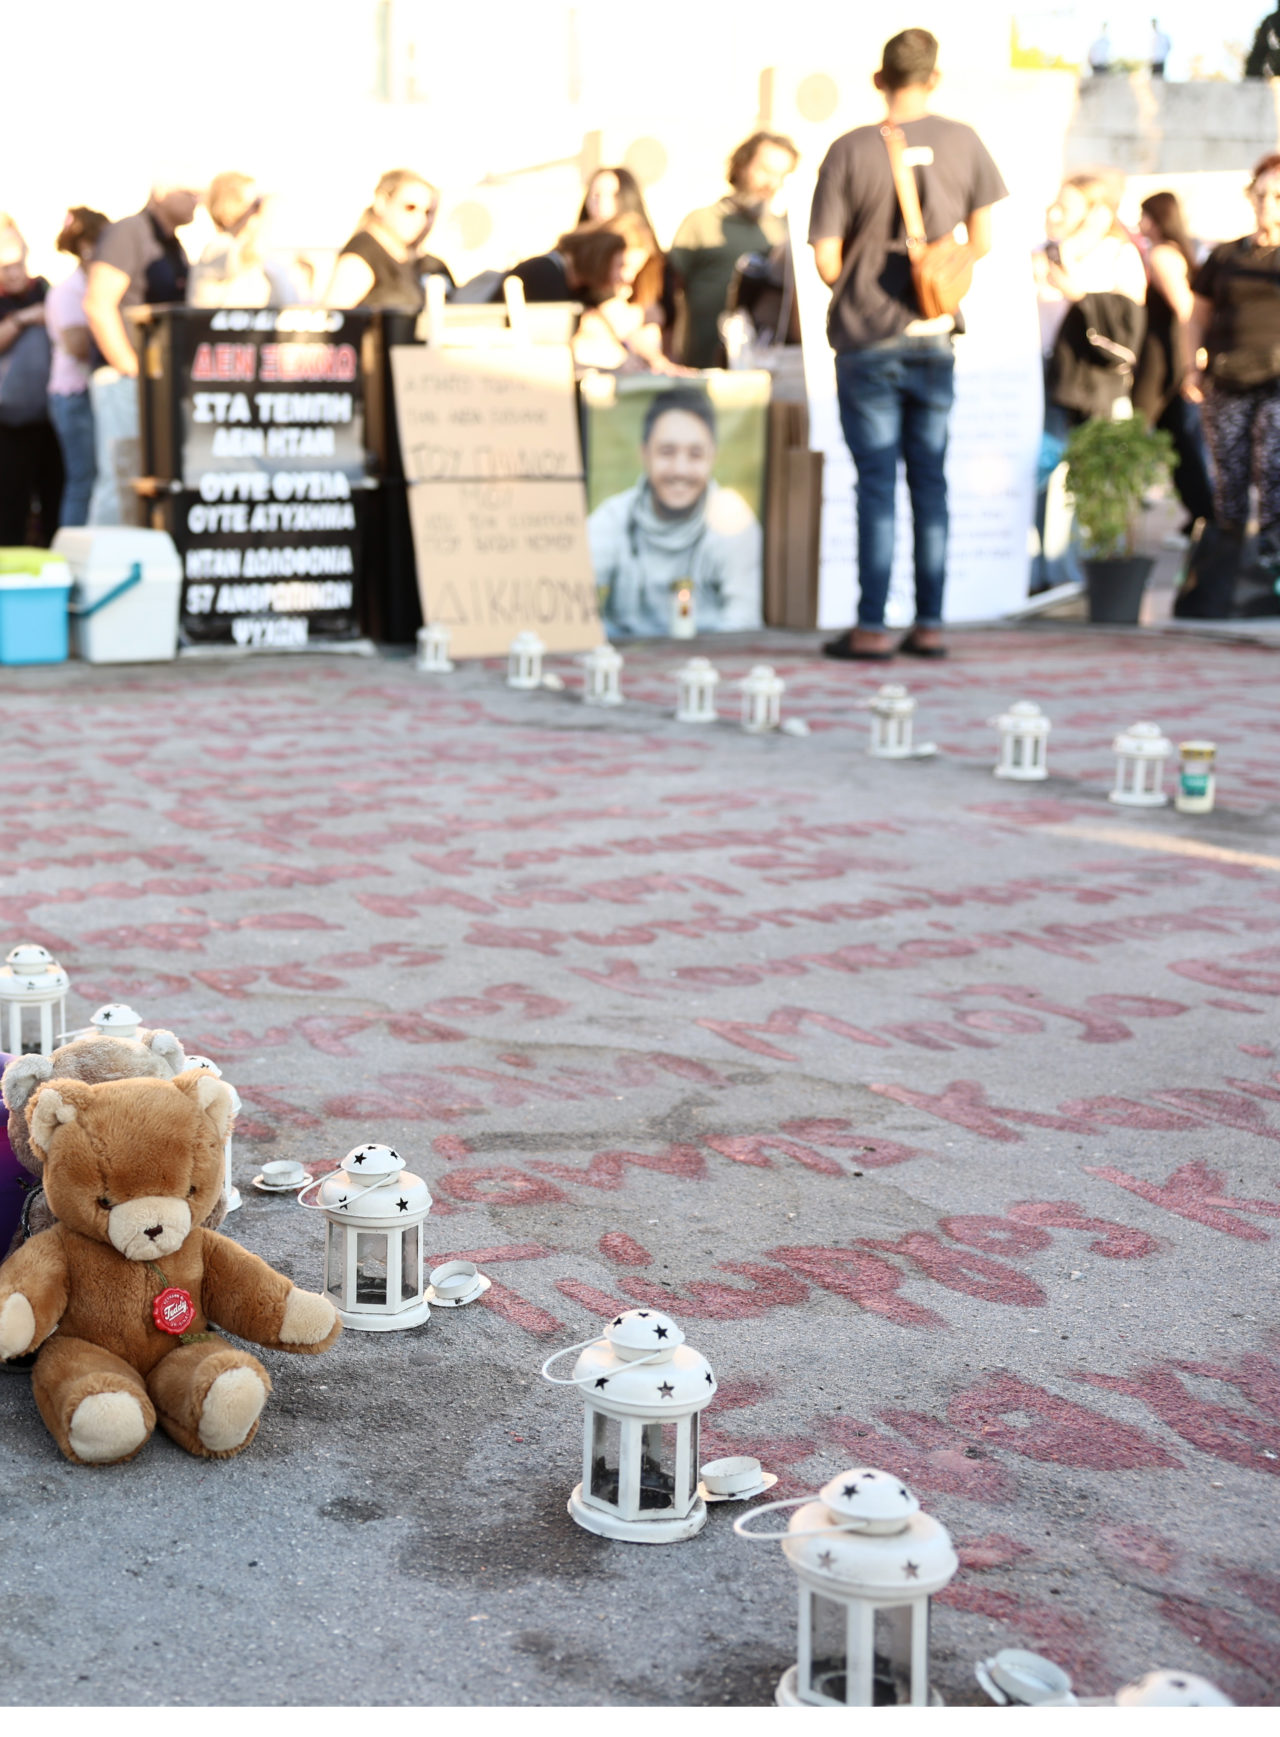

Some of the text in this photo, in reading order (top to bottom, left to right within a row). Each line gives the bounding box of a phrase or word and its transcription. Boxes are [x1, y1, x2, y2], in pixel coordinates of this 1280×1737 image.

[191, 342, 256, 382] ΔΕΝ
[192, 391, 353, 424] ΣΤΑ ΤΕΜΠΗ
[212, 426, 336, 458] ΔΕΝ ΗΤΑΝ
[199, 470, 352, 503] ΟΥΤΕ ΘΥΣΙΑ
[187, 501, 357, 535] ΟΥΤΕ ΑΤΥΧΗΜΑ
[185, 544, 355, 580] ΗΤΑΝ ΔΟΛΟΦΟΝΙΑ
[185, 582, 216, 615] 57
[231, 615, 310, 648] ΨΥΧΩΝ
[163, 1300, 187, 1320] Teddy
